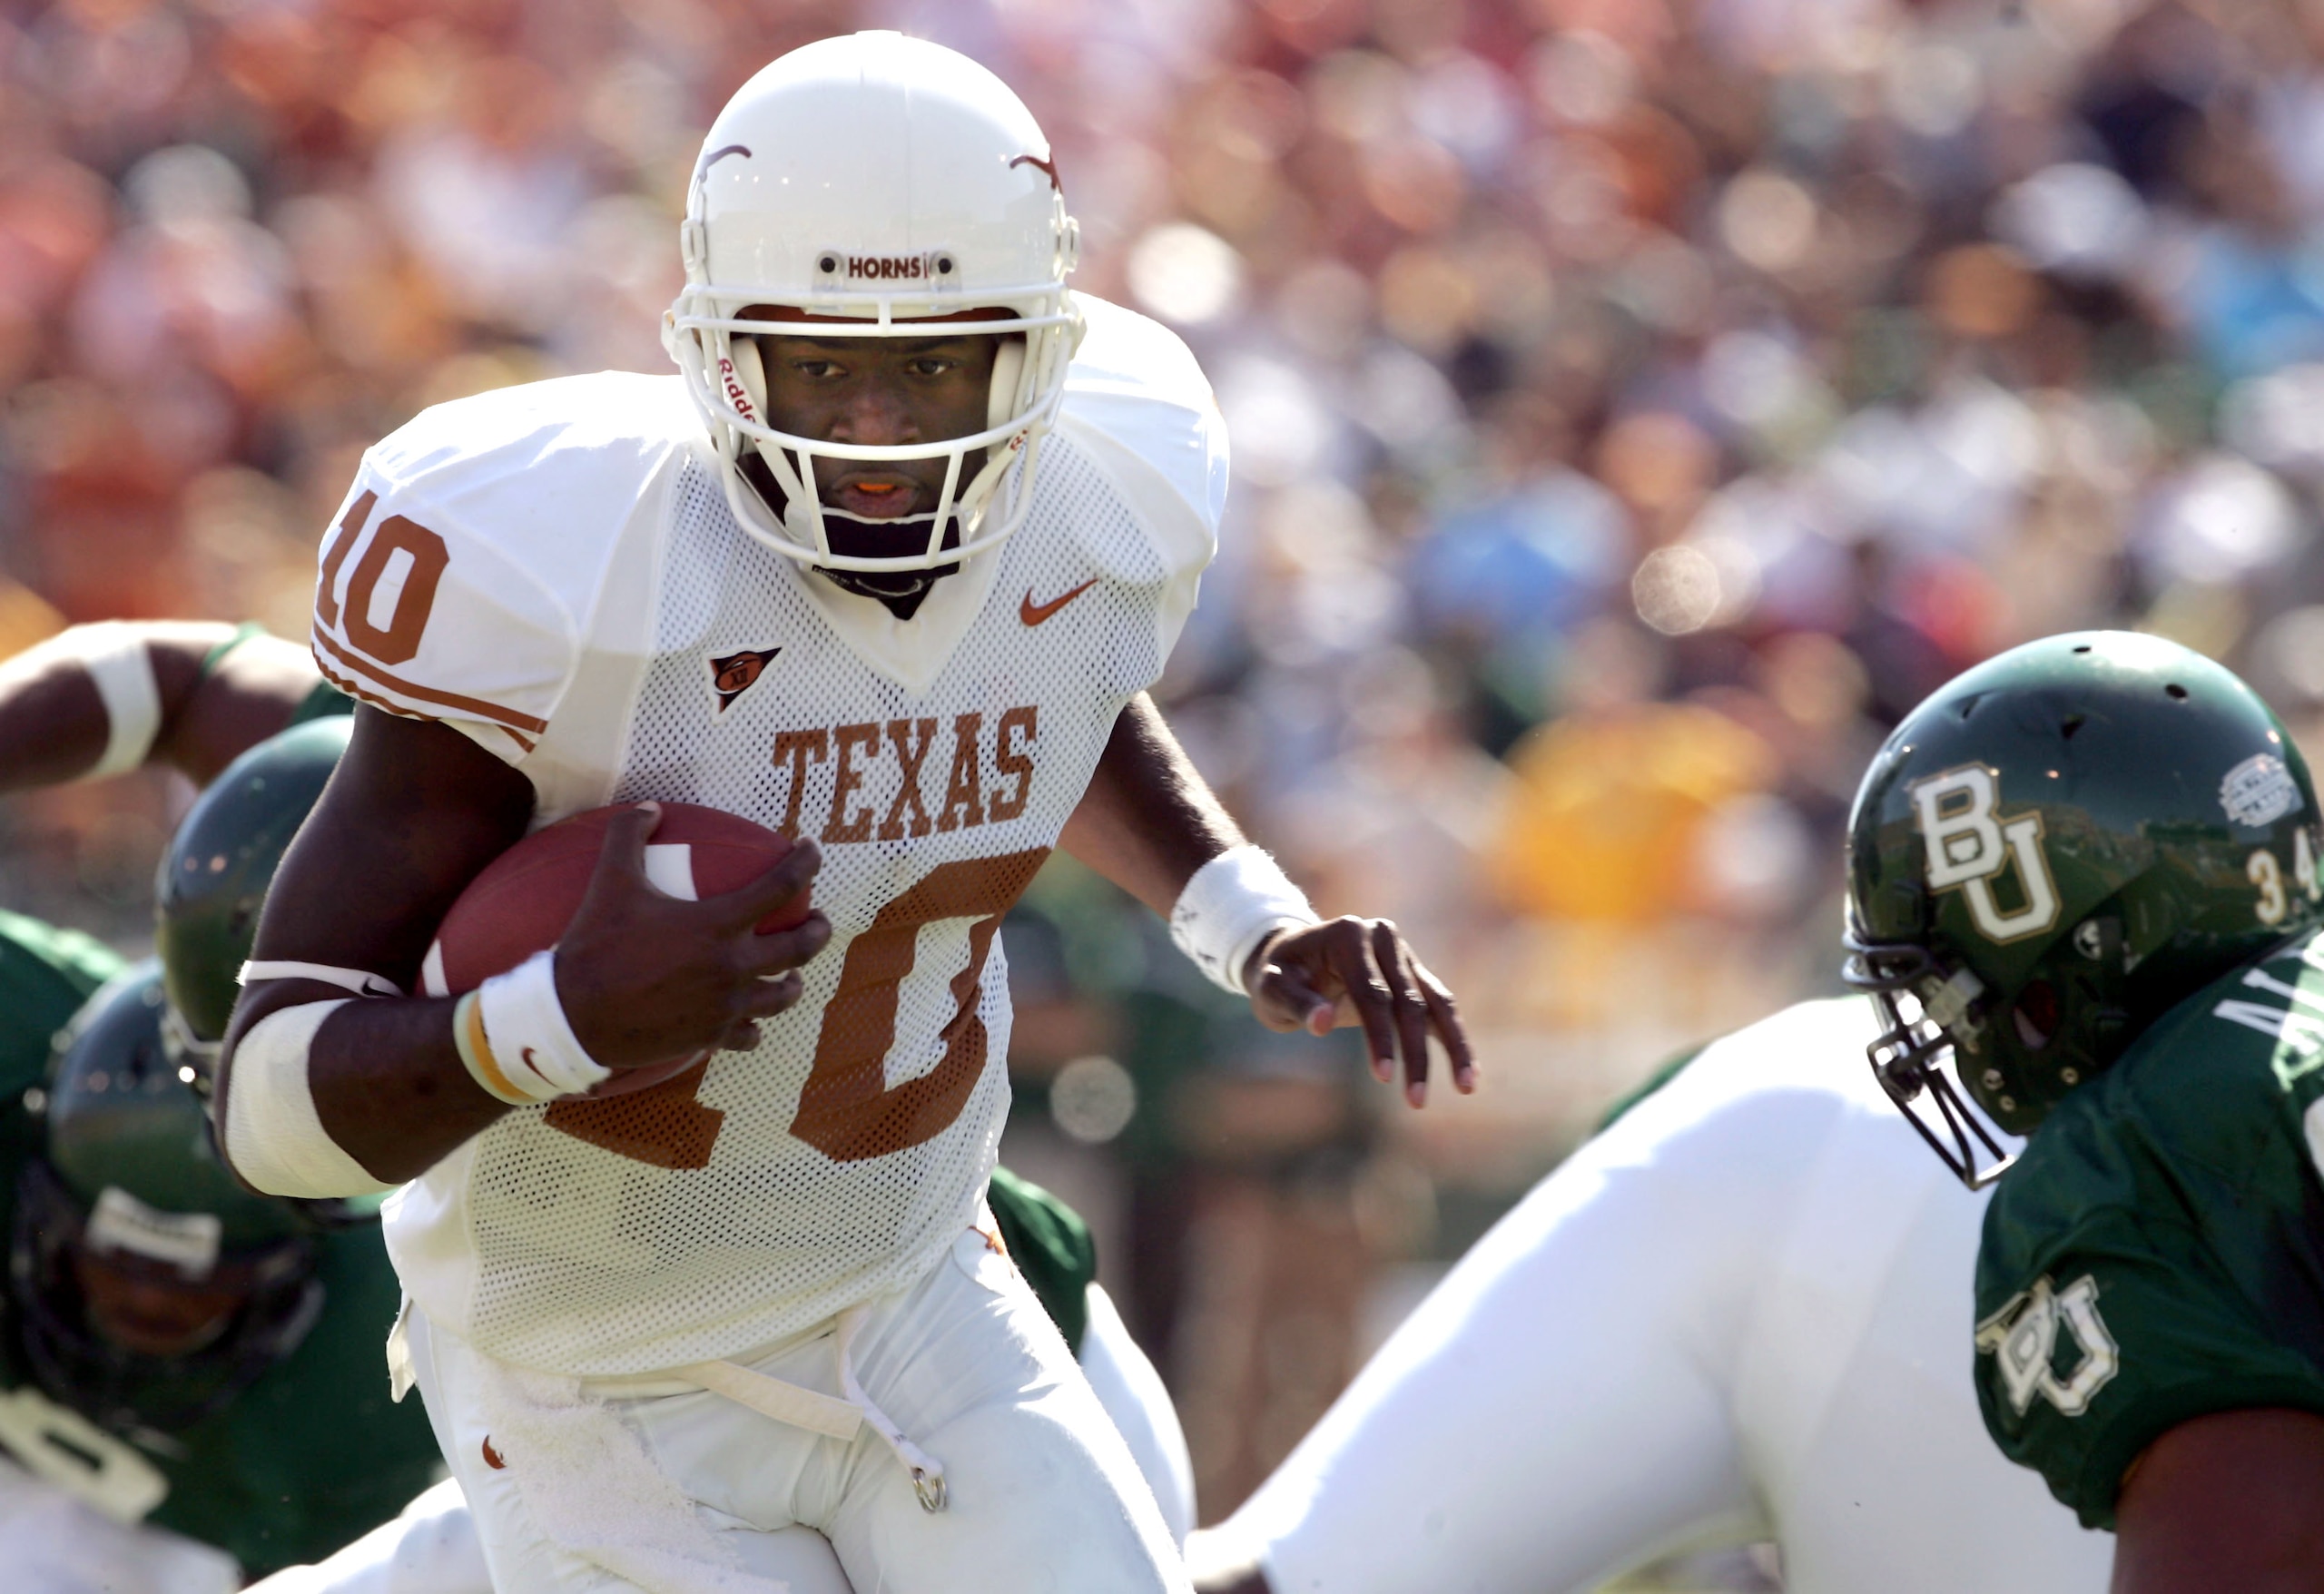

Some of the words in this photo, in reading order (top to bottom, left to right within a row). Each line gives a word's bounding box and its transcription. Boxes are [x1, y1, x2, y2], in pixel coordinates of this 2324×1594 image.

[849, 255, 921, 279] HORNS
[315, 488, 450, 665] 10
[773, 705, 1039, 844] TEXAS
[1909, 760, 2063, 947] BU
